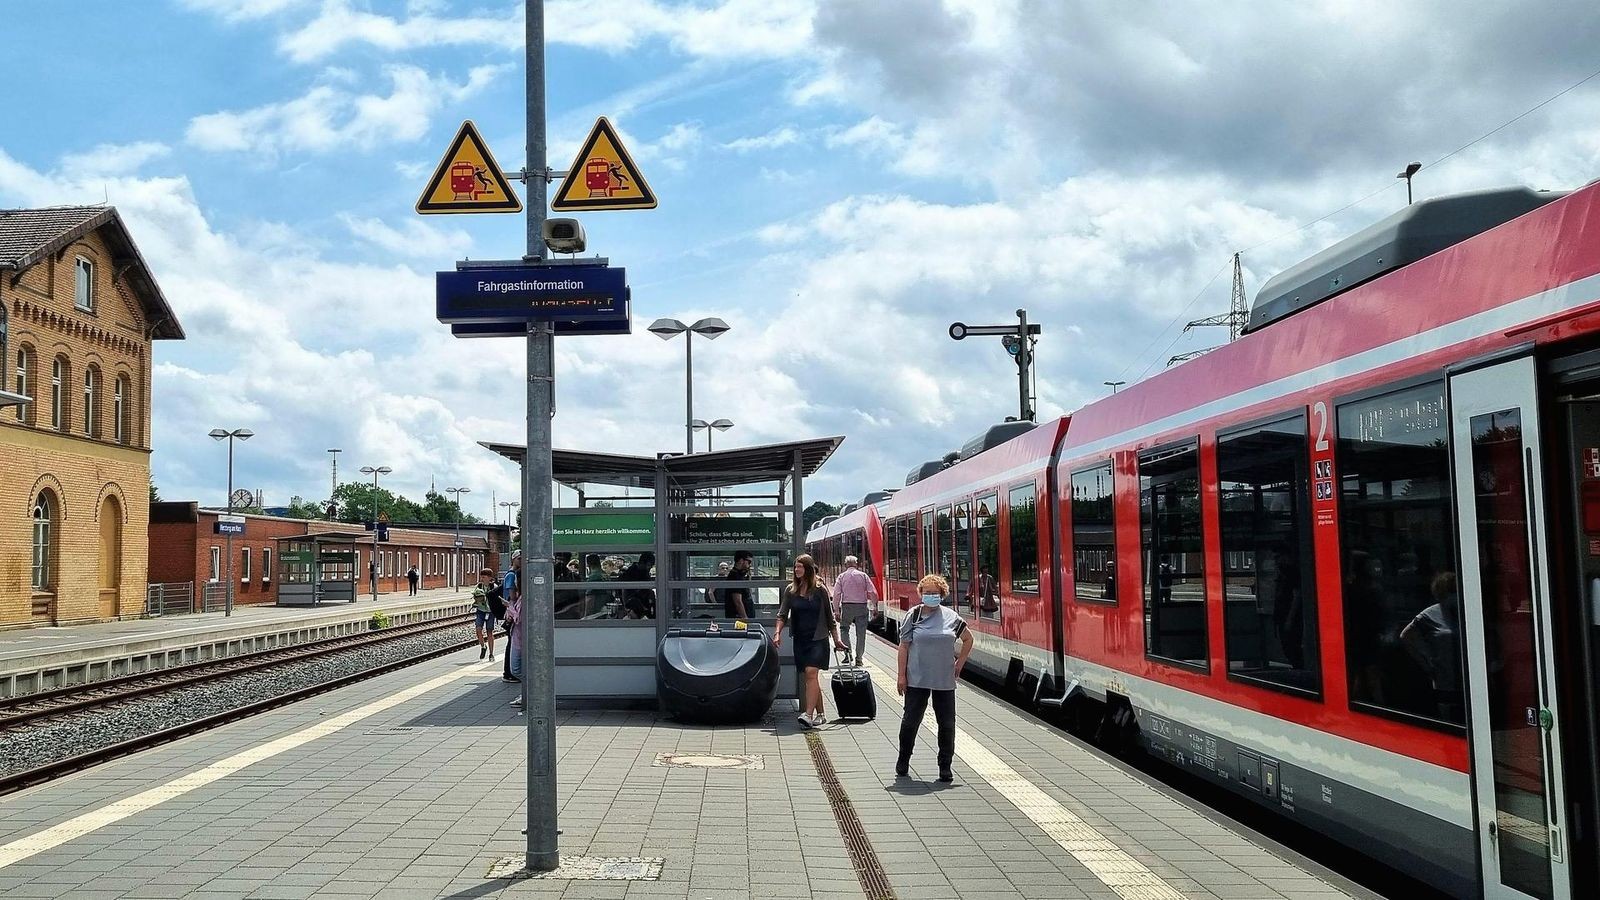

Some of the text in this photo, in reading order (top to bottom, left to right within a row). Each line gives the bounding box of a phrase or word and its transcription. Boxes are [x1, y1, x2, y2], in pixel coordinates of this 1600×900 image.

[477, 279, 584, 293] Fahrgastinformation
[1314, 401, 1329, 451] 2
[384, 531, 388, 540] 1
